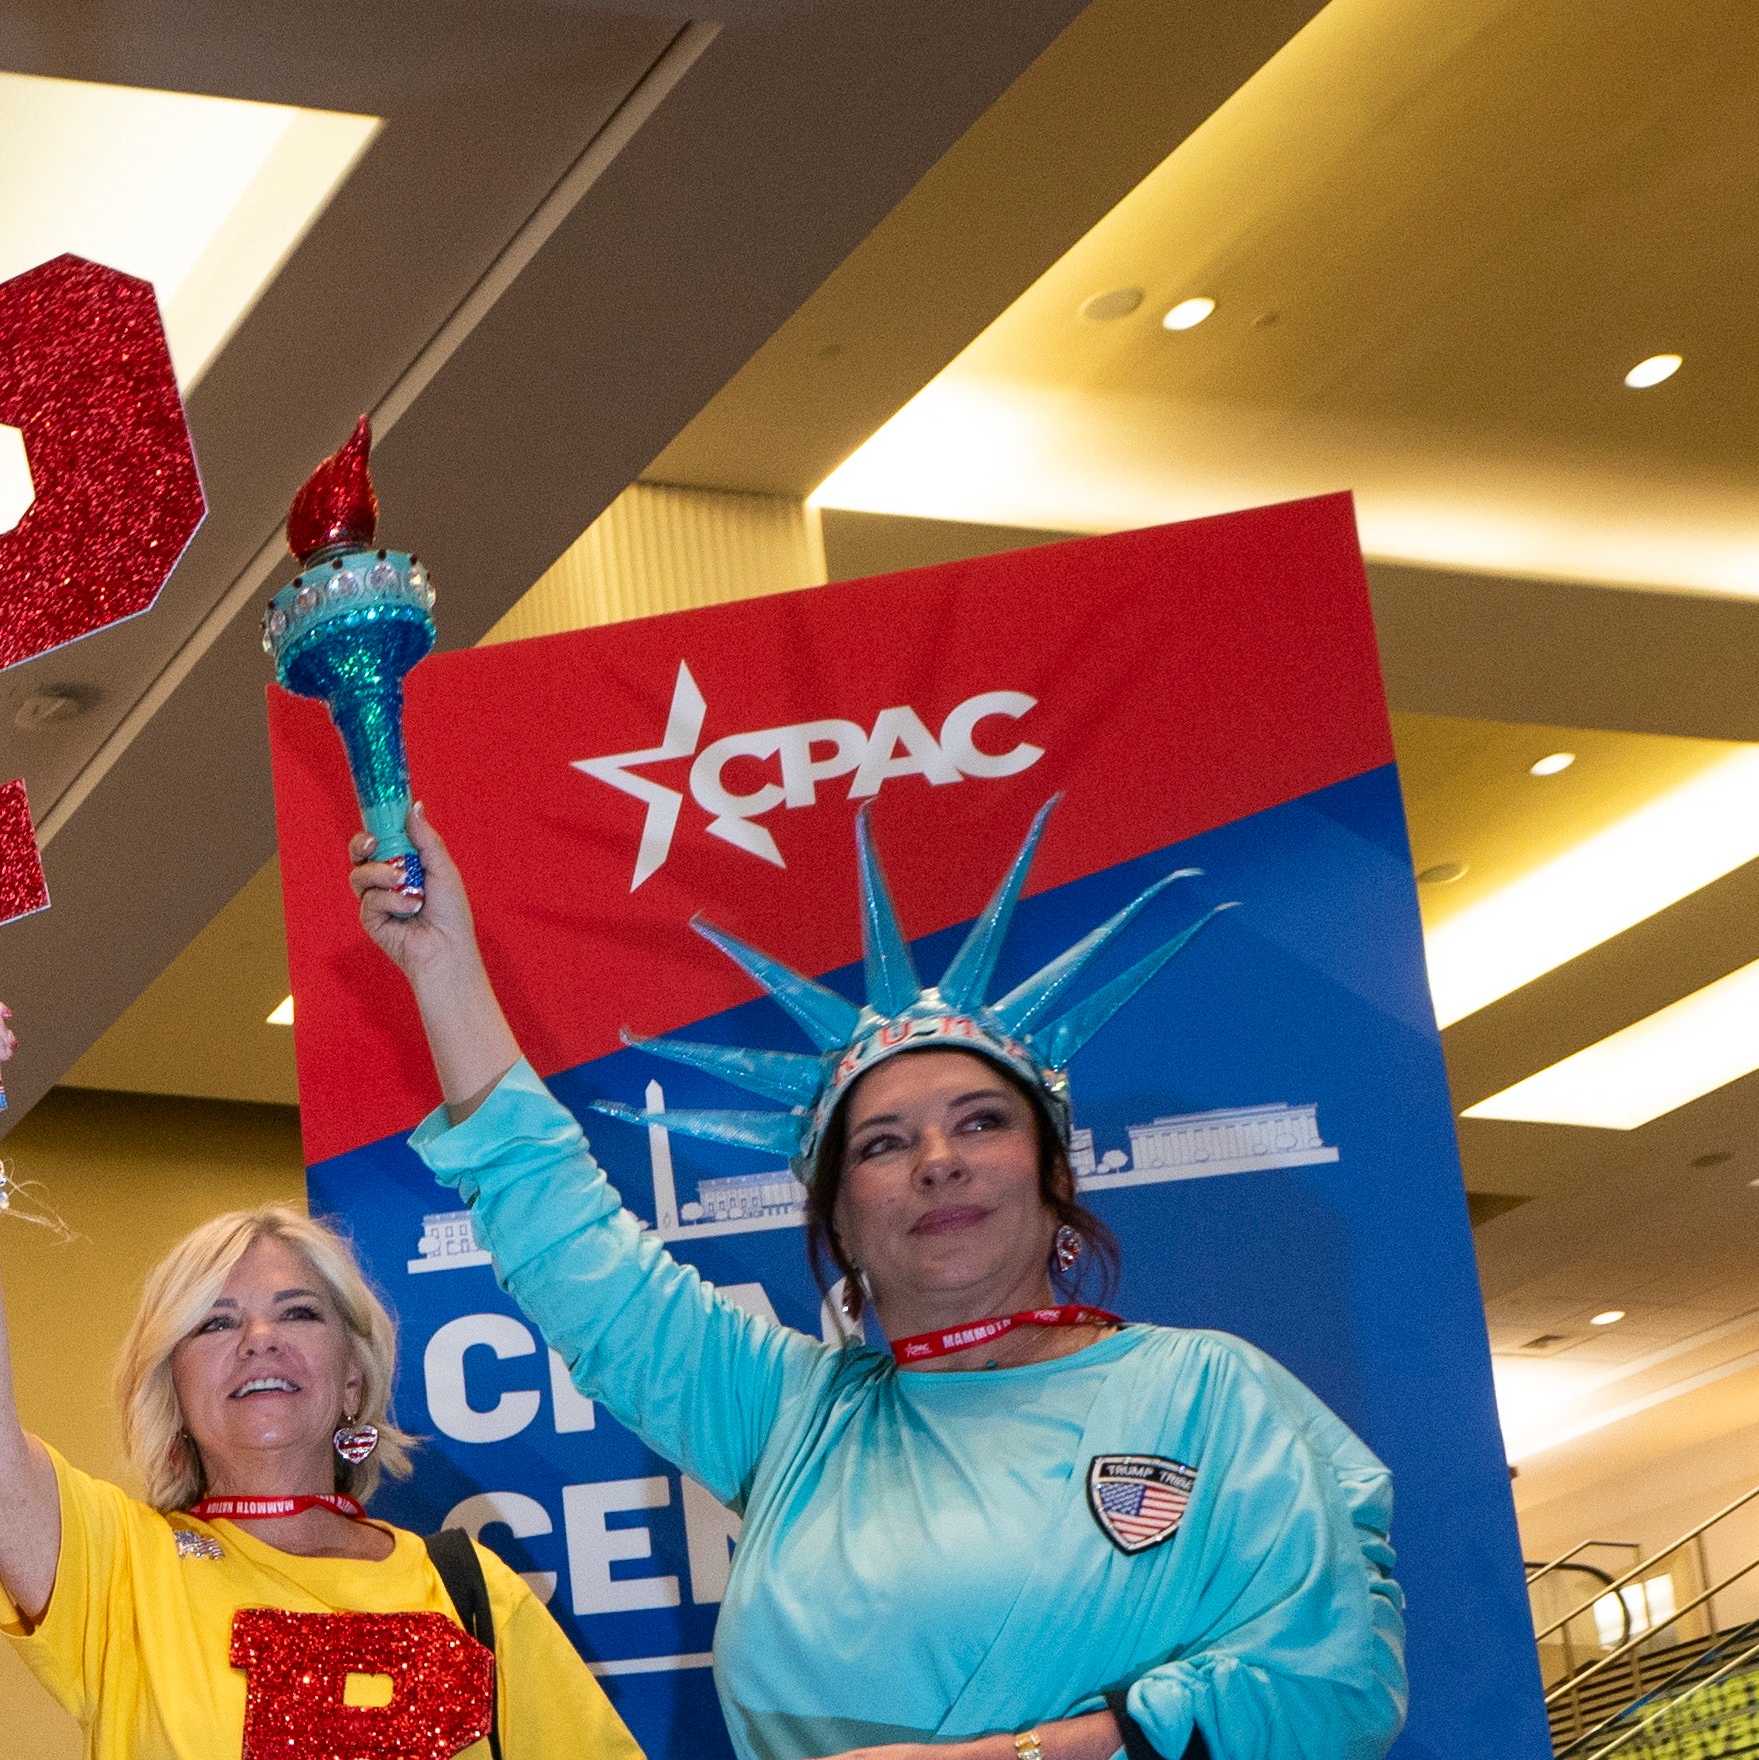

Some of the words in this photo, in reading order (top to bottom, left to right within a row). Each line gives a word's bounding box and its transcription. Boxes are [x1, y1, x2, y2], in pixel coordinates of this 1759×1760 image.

[689, 690, 1045, 818] CPAC
[942, 1319, 1011, 1348] MAMMOTH
[1106, 1464, 1154, 1478] TRUMP
[237, 1500, 294, 1514] MAMMOTH
